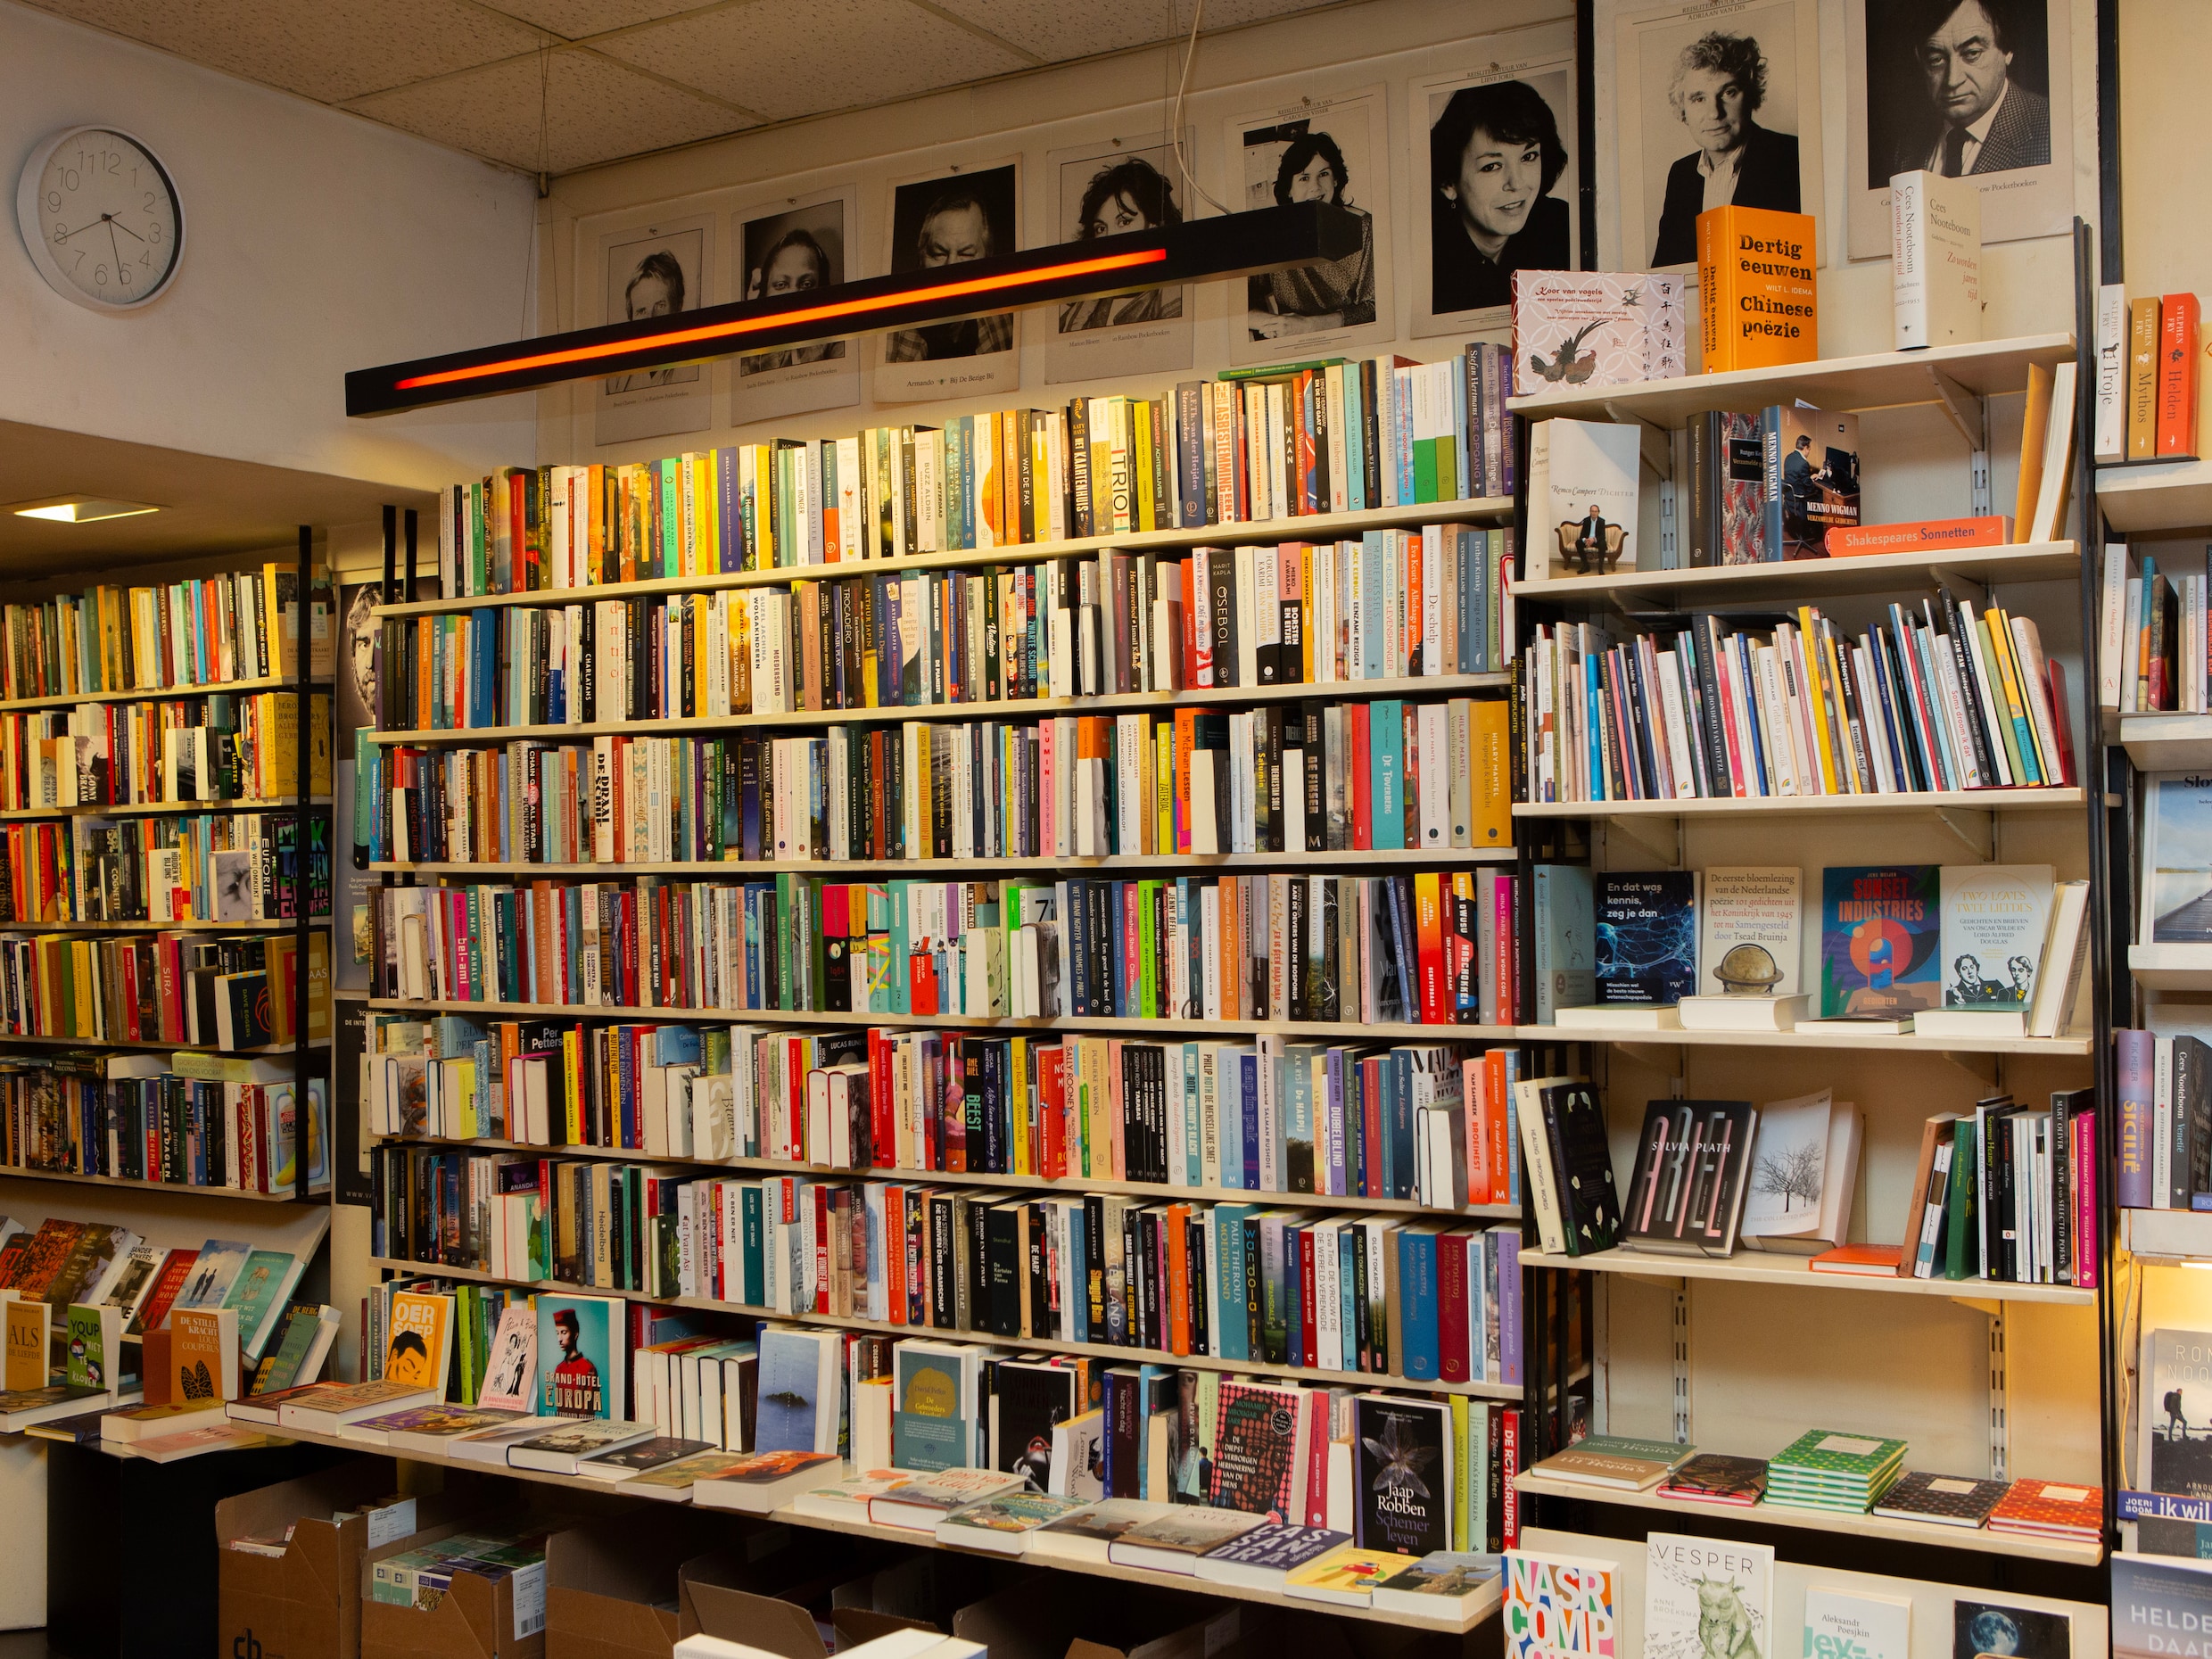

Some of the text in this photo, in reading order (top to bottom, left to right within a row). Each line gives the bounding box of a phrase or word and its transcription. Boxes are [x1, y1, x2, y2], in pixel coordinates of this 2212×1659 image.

[78, 151, 95, 174] 11
[100, 151, 121, 175] 12
[58, 168, 79, 191] 10
[131, 168, 137, 187] 1
[1992, 179, 2037, 192] Pocketboeken
[48, 191, 61, 212] 9
[143, 192, 155, 214] 2
[1930, 198, 1946, 213] Cees
[54, 223, 68, 245] 8
[149, 222, 161, 243] 3
[1895, 189, 1905, 276] Zo worden jaren tijd
[1905, 186, 1914, 273] Cees Nooteboom
[1930, 213, 1971, 235] Nooteboom
[1739, 235, 1802, 260] Dertig
[75, 250, 86, 270] 7
[139, 251, 151, 269] 4
[1740, 258, 1812, 281] eeuwen
[95, 264, 108, 285] 6
[120, 263, 132, 285] 5
[1536, 287, 1561, 295] Koor
[1579, 288, 1603, 296] vogels
[1791, 287, 1812, 295] IDEMA
[1740, 295, 1813, 318] Chinese
[1742, 320, 1800, 340] poëzie
[2176, 305, 2184, 344] STEPHEN
[2098, 361, 2118, 405] Troje
[2138, 373, 2152, 424] Mythos
[2167, 370, 2182, 420] Helden
[1023, 477, 1029, 487] DE
[1075, 451, 1088, 513] KAARTENHUIS
[1110, 455, 1128, 512] TRIO
[1551, 484, 1634, 498] Remco Campert DICHTER
[1807, 501, 1857, 516] MENNO WIGMAN
[1845, 527, 1975, 547] Shakespeares Sonnetten
[1213, 562, 1231, 570] MARIT
[1217, 586, 1228, 648] OSEBOL
[1284, 607, 1291, 617] EN
[1426, 594, 1441, 644] De schelp
[1291, 607, 1299, 646] BORSTEN
[1258, 752, 1266, 788] Saturnin
[1183, 772, 1191, 802] Lessen
[261, 837, 271, 896] EUFORIE
[111, 868, 120, 911] COGNETTI
[1607, 883, 1663, 892] En dat was
[1746, 874, 1795, 885] bloemlezing
[1853, 878, 1909, 900] SUNSET
[1607, 896, 1641, 905] kennis,
[1730, 886, 1739, 894] de
[1741, 886, 1790, 895] Nederlandse
[1711, 897, 1734, 907] poëzie
[1747, 898, 1783, 907] gedichten
[1839, 899, 1923, 922] INDUSTRIES
[1955, 903, 1987, 913] TWEE
[1607, 909, 1657, 919] zeg je dan
[1711, 909, 1721, 917] het
[1722, 909, 1760, 920] Koninkrijk
[1776, 911, 1793, 920] 1945
[1714, 920, 1722, 929] tot
[1735, 920, 1788, 930] Samengesteld
[1714, 932, 1731, 940] door
[1757, 932, 1787, 943] Bruinja
[458, 937, 469, 985] bel-ami
[162, 967, 171, 997] SIRA
[1460, 945, 1470, 1005] NASCHOKKEN
[1065, 1046, 1075, 1112] SALLY ROONEY
[913, 1094, 923, 1138] SERGE
[965, 1094, 982, 1132] BEEST
[1331, 1106, 1342, 1167] DUBBELBLIND
[1472, 1122, 1480, 1171] BROEINEST
[1652, 1141, 1731, 1153] SYLVIA PLATH
[2124, 1100, 2140, 1174] SICILIË
[2176, 1123, 2185, 1153] Venetië
[1220, 1223, 1231, 1300] MOEDERLAND
[1231, 1220, 1242, 1304] PAUL THEROUX
[1090, 1269, 1102, 1324] Shuggie Bain
[180, 1316, 218, 1329] DE STILLE
[394, 1302, 435, 1325] OER
[9, 1326, 39, 1348] ALS
[71, 1317, 100, 1337] YOUP
[188, 1325, 219, 1336] KRACHT
[87, 1341, 102, 1353] NIET
[182, 1342, 219, 1354] COUPERUS
[199, 1335, 219, 1345] LOUIS
[8, 1349, 41, 1359] DE LIEFDE
[79, 1355, 87, 1365] TE
[72, 1370, 97, 1388] KLOVEN
[545, 1384, 602, 1411] EUROPA
[1224, 1444, 1244, 1454] DIEPST
[1224, 1453, 1258, 1465] VERBORGEN
[1218, 1461, 1256, 1473] HERINNERING
[1223, 1472, 1234, 1480] VAN
[1222, 1480, 1238, 1489] MENS
[1386, 1482, 1415, 1499] Jaap
[1505, 1430, 1517, 1537] DE ROTSKRUIPER
[1377, 1496, 1426, 1516] Robben
[2125, 1498, 2152, 1506] JOERI
[2125, 1505, 2152, 1514] BOOM
[2159, 1498, 2177, 1515] ik
[1375, 1513, 1430, 1535] Schemer
[1386, 1527, 1418, 1546] leven
[1655, 1543, 1754, 1574] VESPER
[1514, 1557, 1606, 1614] NASR
[1821, 1614, 1860, 1627] Aleksandr
[1837, 1626, 1869, 1639] Poesjkin
